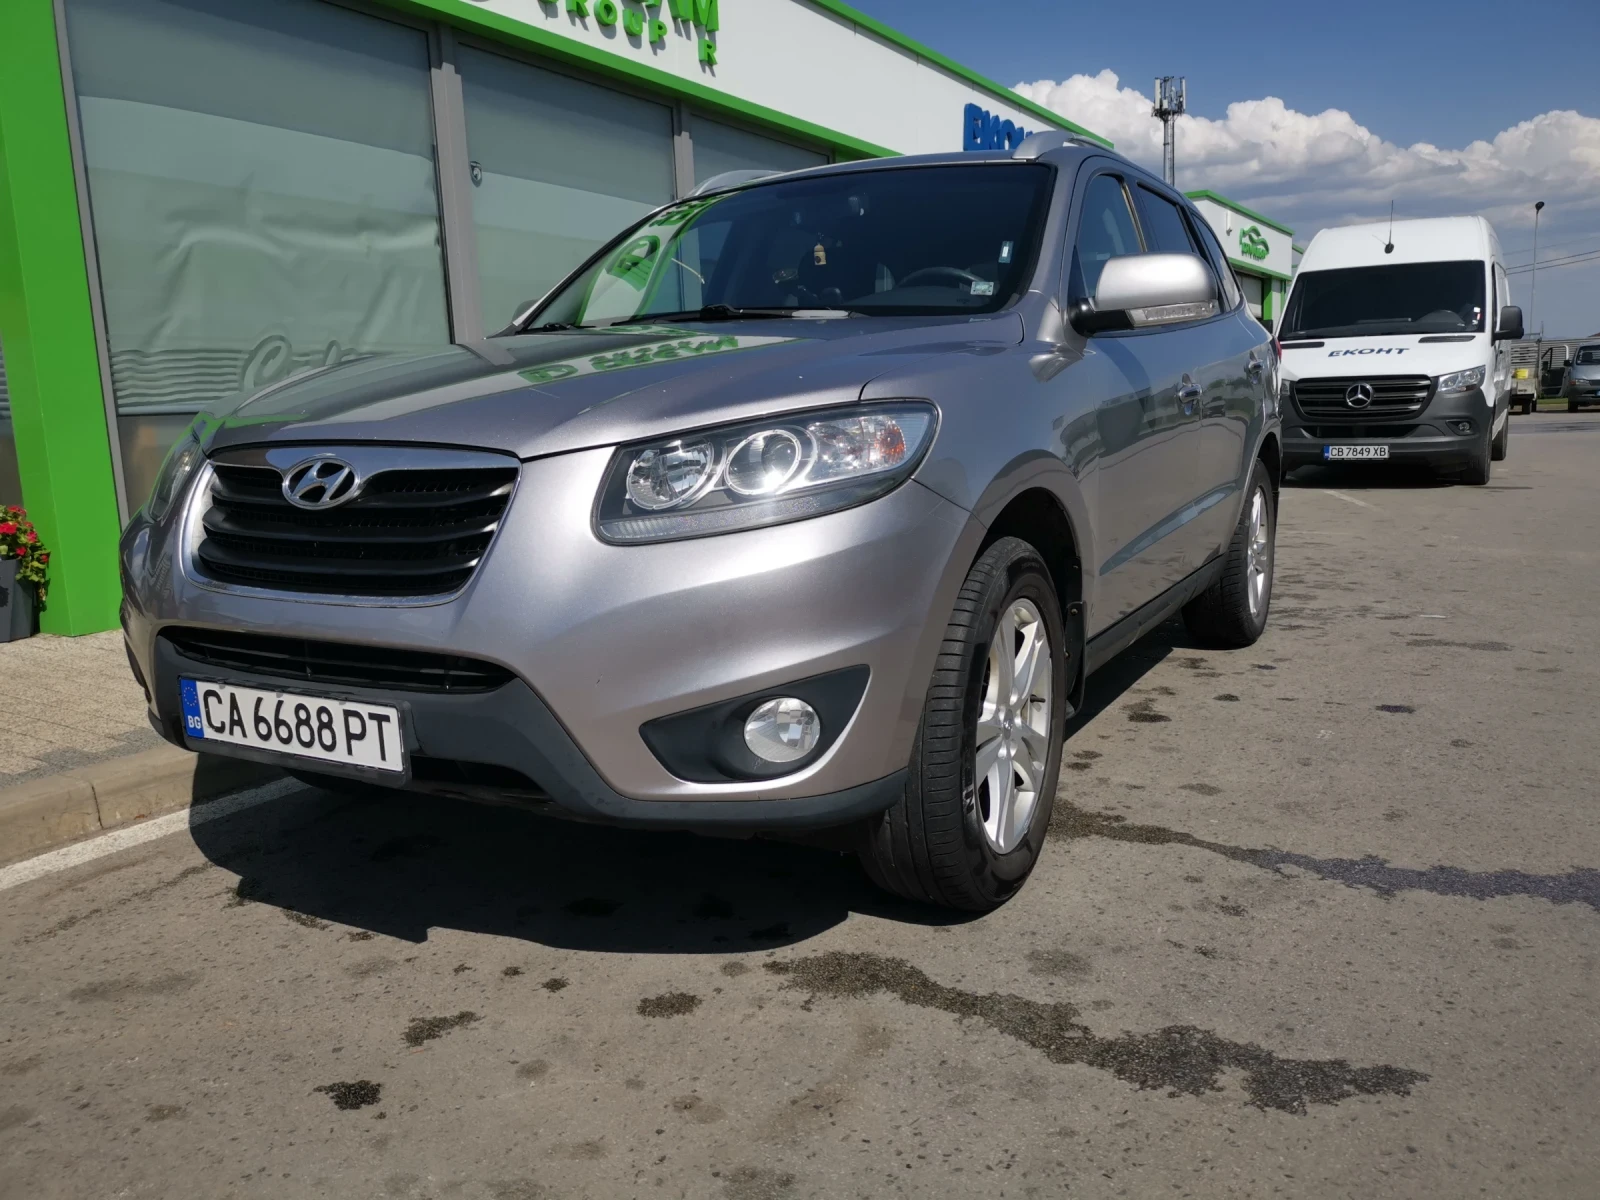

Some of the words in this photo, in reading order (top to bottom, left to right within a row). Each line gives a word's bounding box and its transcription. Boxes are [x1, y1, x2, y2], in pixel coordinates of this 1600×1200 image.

[539, 0, 667, 43] ROUP
[1346, 447, 1371, 457] 7849
[187, 715, 201, 729] BG
[203, 689, 247, 738] CA
[253, 696, 336, 752] 6688
[342, 709, 391, 761] PT
